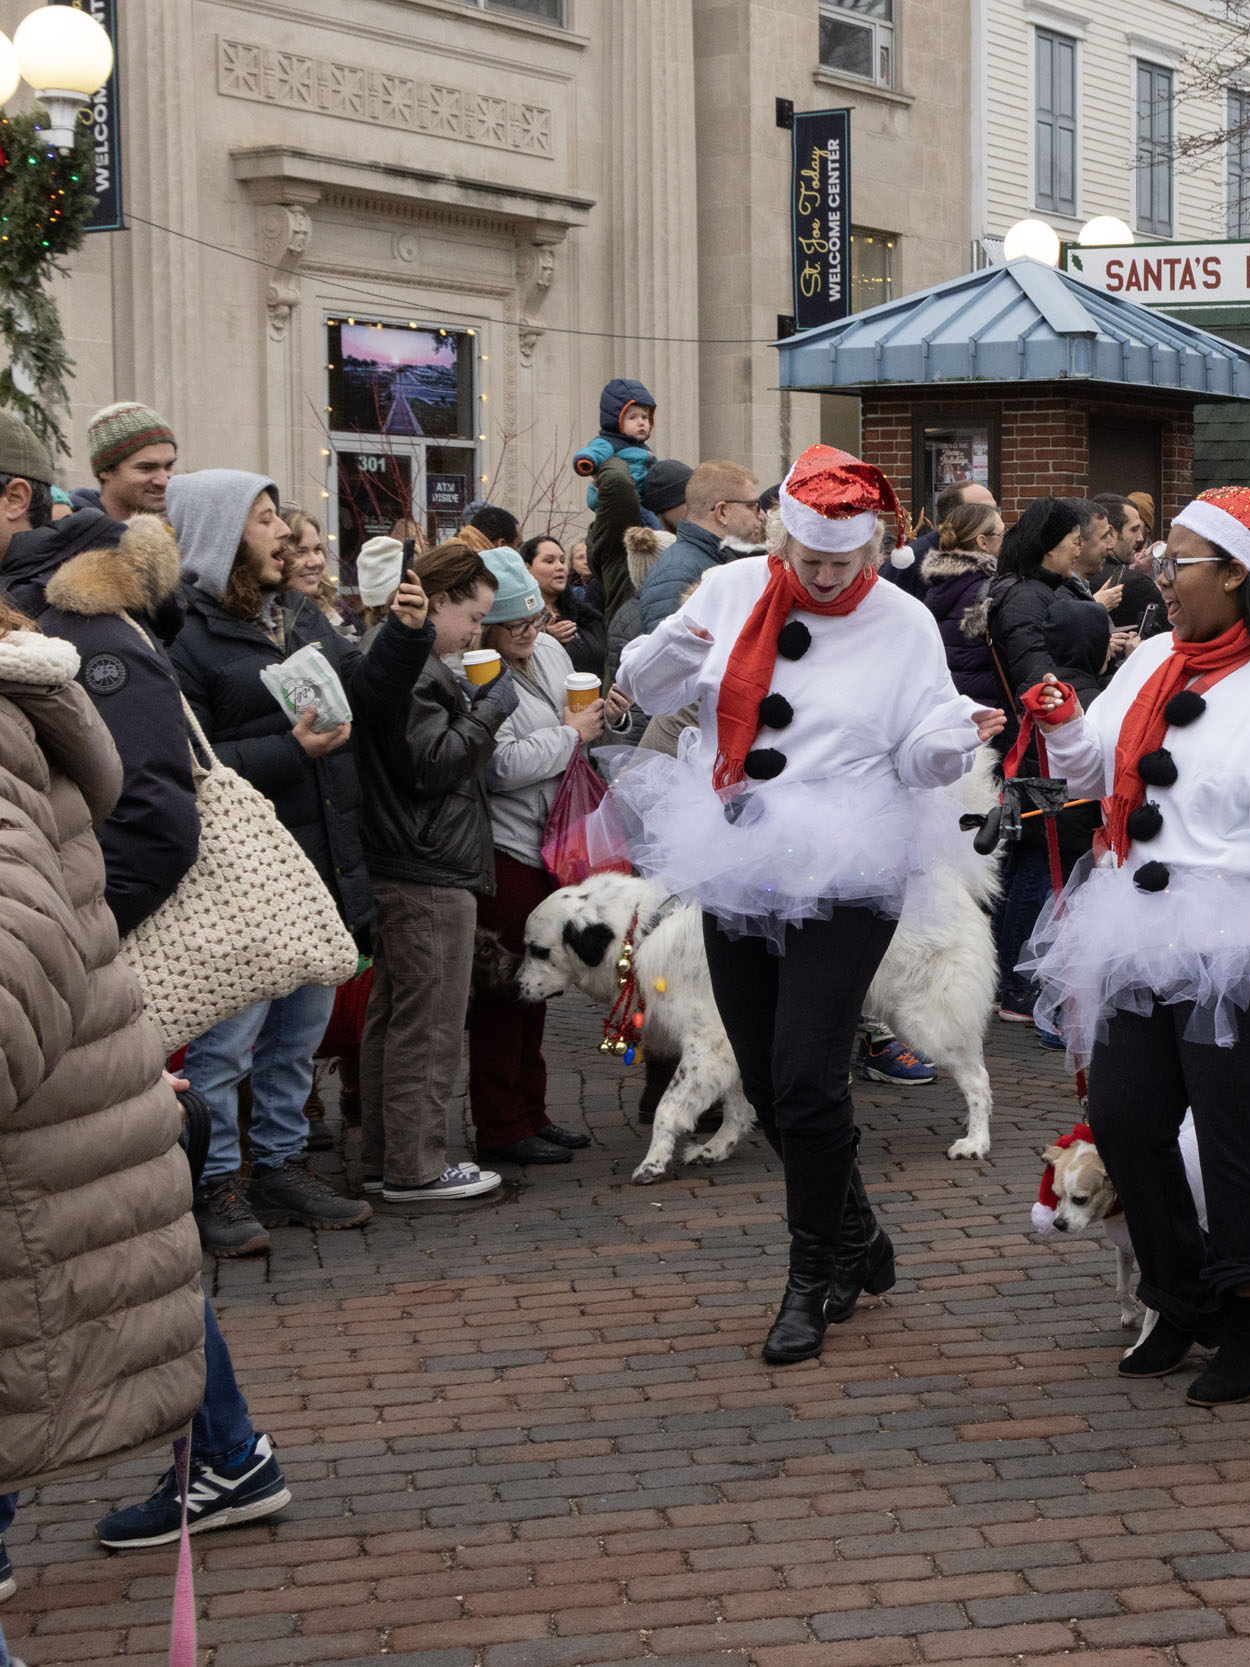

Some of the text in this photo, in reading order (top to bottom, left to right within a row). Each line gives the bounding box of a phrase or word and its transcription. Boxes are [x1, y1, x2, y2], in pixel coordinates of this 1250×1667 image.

[93, 83, 110, 192] WELCOM
[799, 146, 831, 297] St. Joe Today
[827, 139, 841, 302] WELCOME CENTER
[1105, 256, 1221, 291] SANTA'S
[358, 455, 387, 472] 301
[435, 482, 456, 492] ATM
